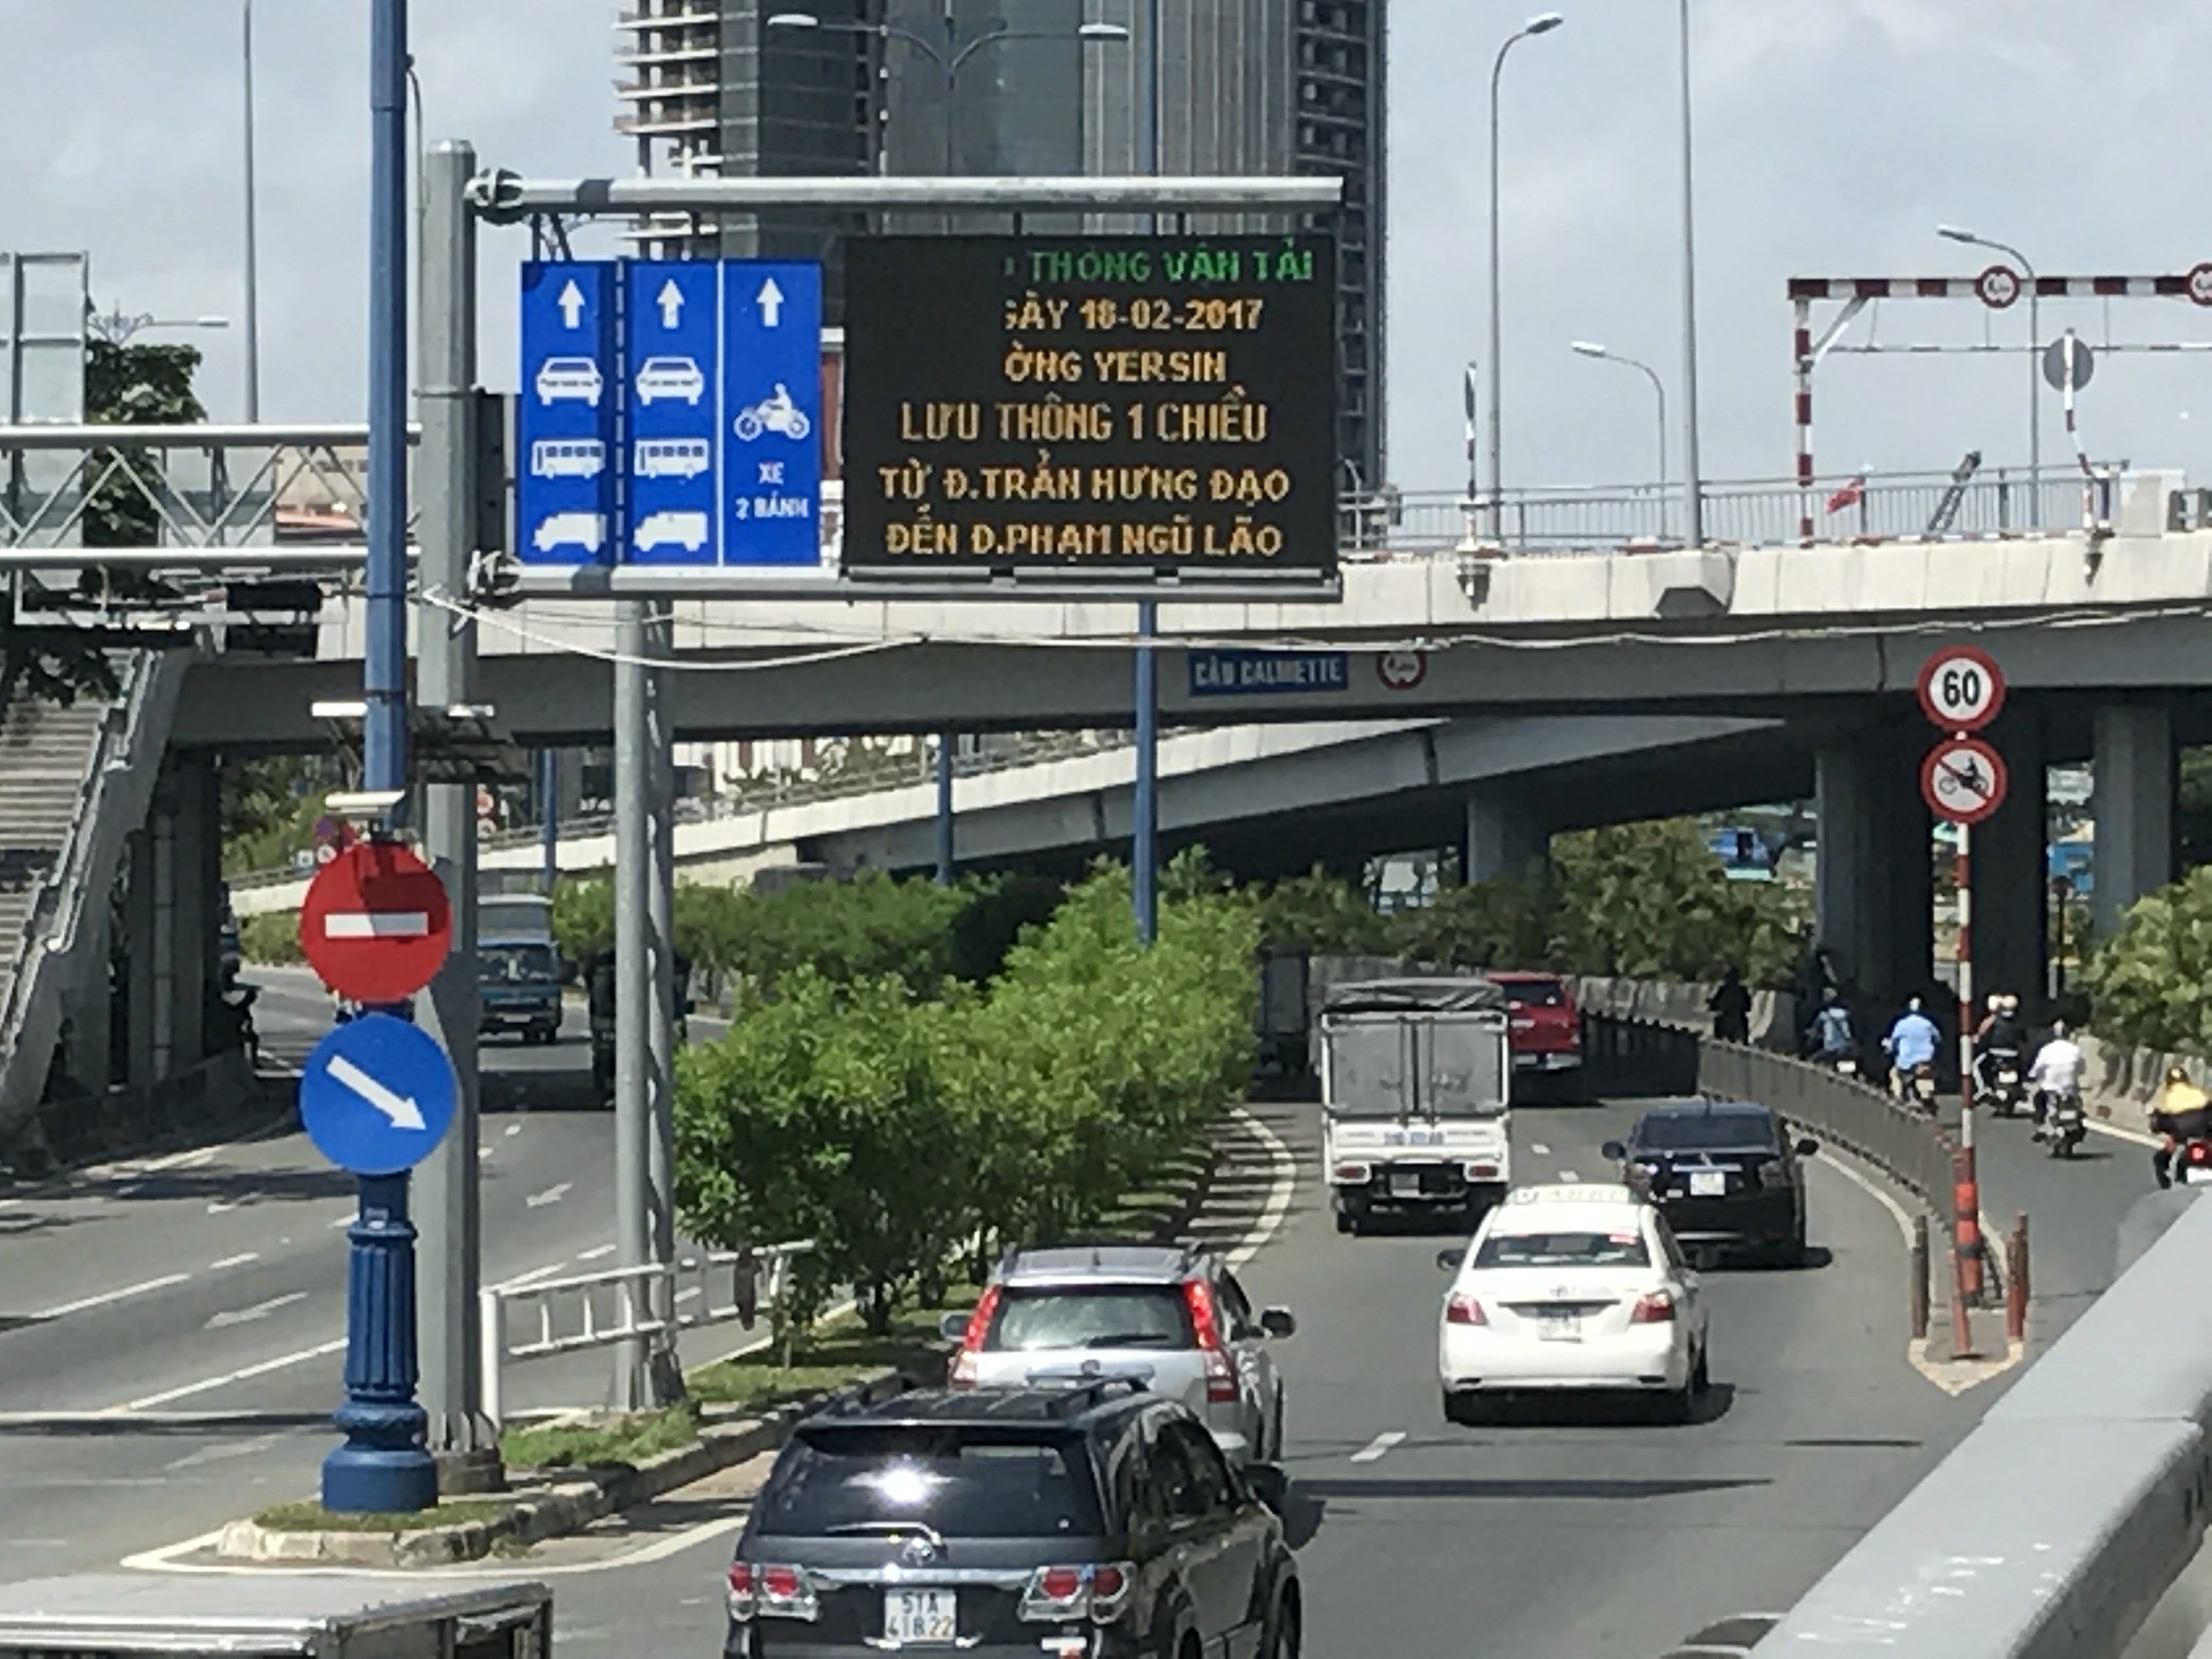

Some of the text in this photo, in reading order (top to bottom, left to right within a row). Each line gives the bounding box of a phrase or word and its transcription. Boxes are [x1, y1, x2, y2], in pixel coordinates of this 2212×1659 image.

[1093, 350, 1227, 382] YERSIN
[901, 385, 1268, 442] LƯU THÔNG 1 CHIỀU
[759, 461, 785, 486] XE
[878, 456, 932, 499] TỪ
[1091, 466, 1198, 501] HƯNG
[1209, 469, 1290, 507] ĐẠO
[736, 490, 809, 520] 2 BÁNH
[885, 504, 957, 555] ĐẾN
[1121, 514, 1193, 555] NGŨ
[1204, 516, 1283, 556] LÃO
[1943, 669, 1980, 708] 60
[901, 1592, 939, 1614] 51A
